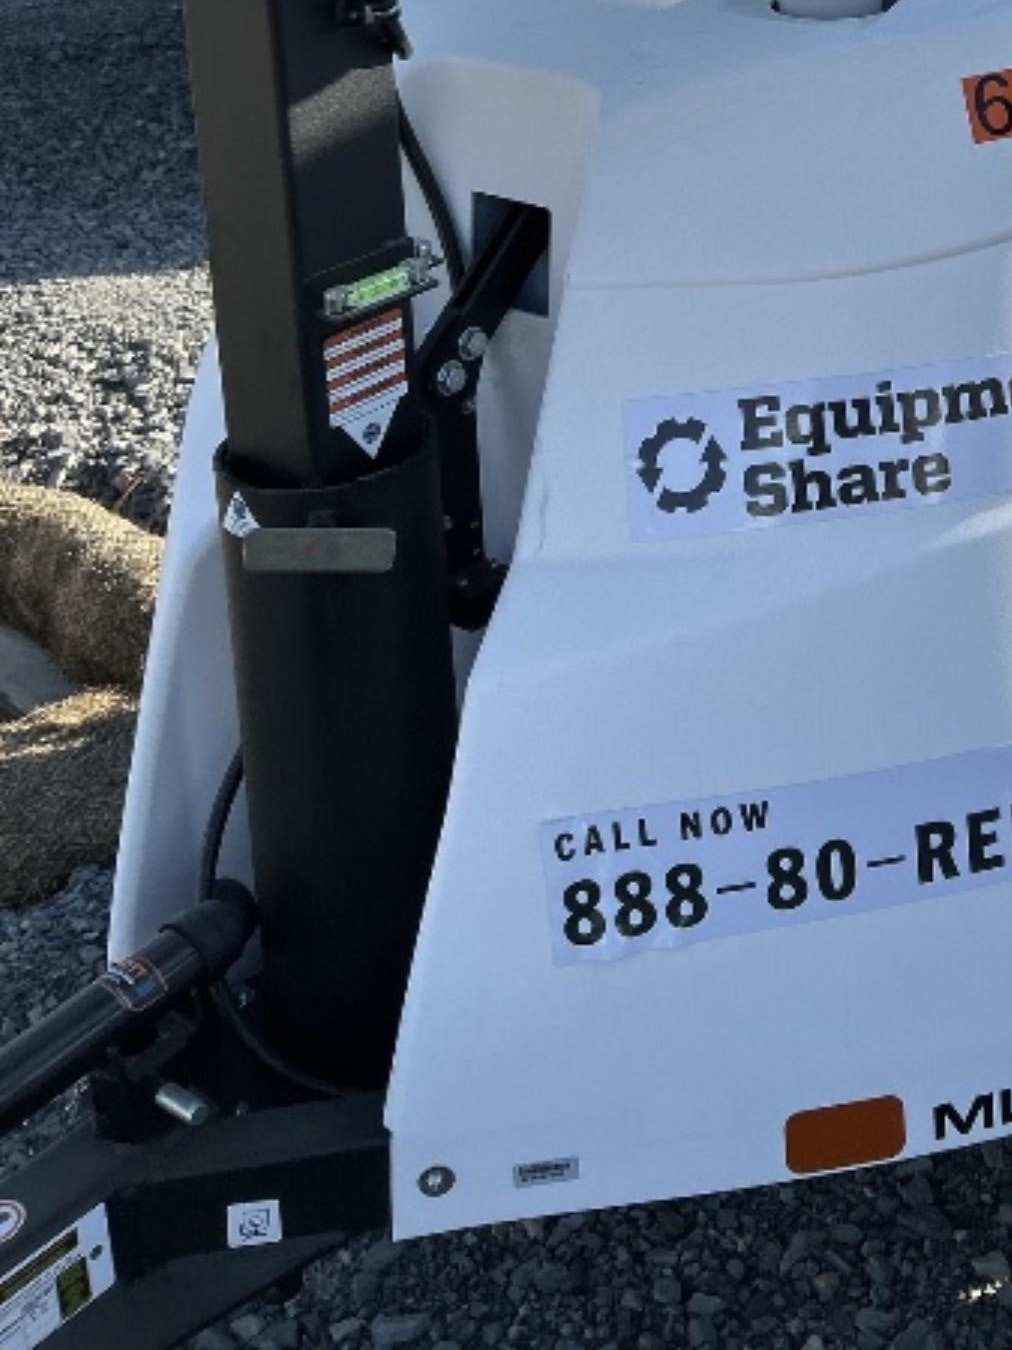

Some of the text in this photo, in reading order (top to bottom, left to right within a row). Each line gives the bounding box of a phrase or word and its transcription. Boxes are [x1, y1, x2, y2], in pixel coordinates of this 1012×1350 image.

[742, 453, 951, 517] Share
[554, 800, 768, 861] CALL NOW
